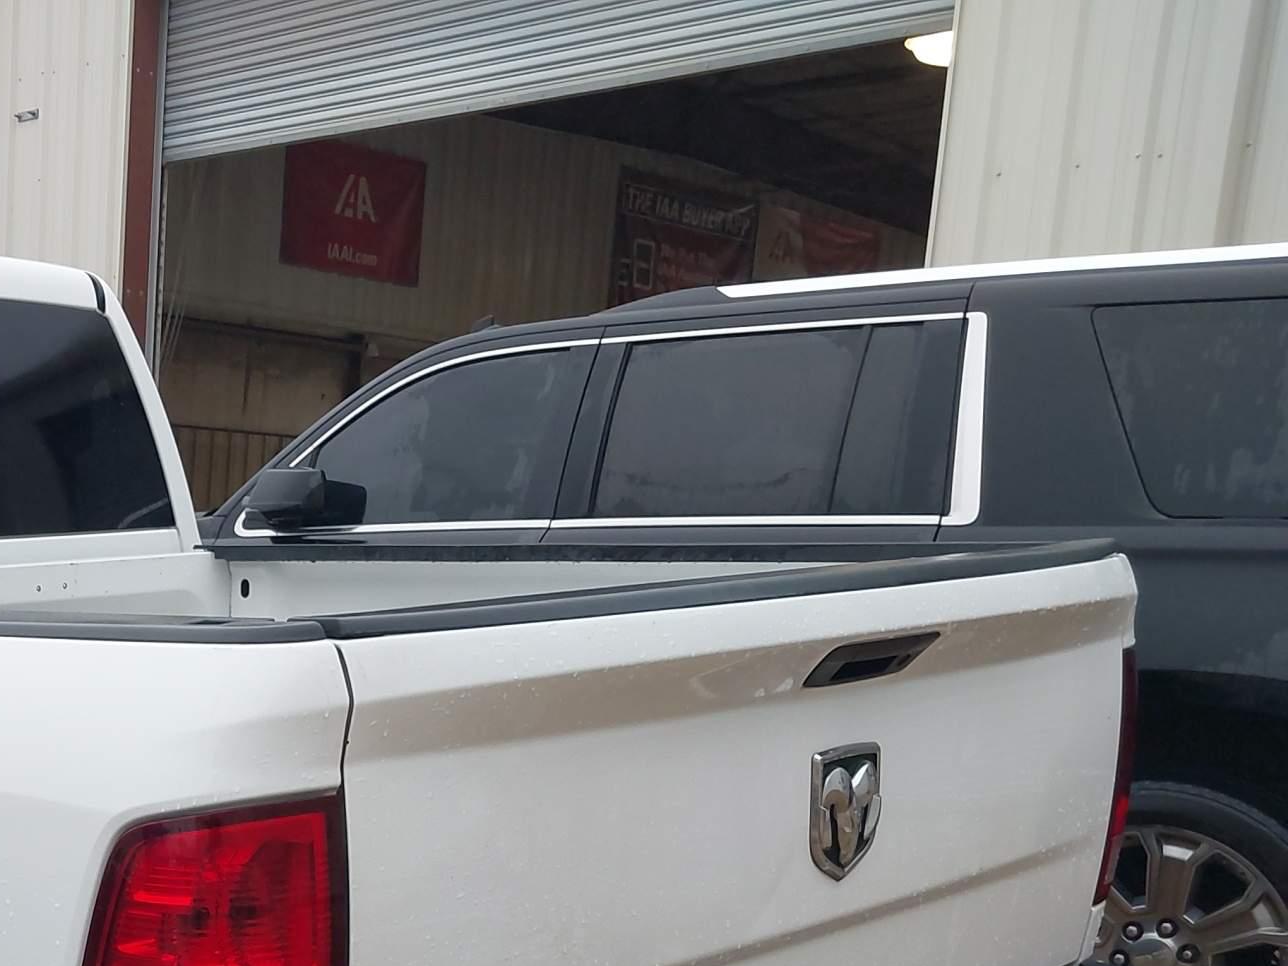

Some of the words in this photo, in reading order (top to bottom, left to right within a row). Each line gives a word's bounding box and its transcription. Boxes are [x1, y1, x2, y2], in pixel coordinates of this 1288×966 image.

[626, 186, 654, 212] THE
[655, 194, 680, 220] IAA
[327, 241, 378, 267] IAAI.com
